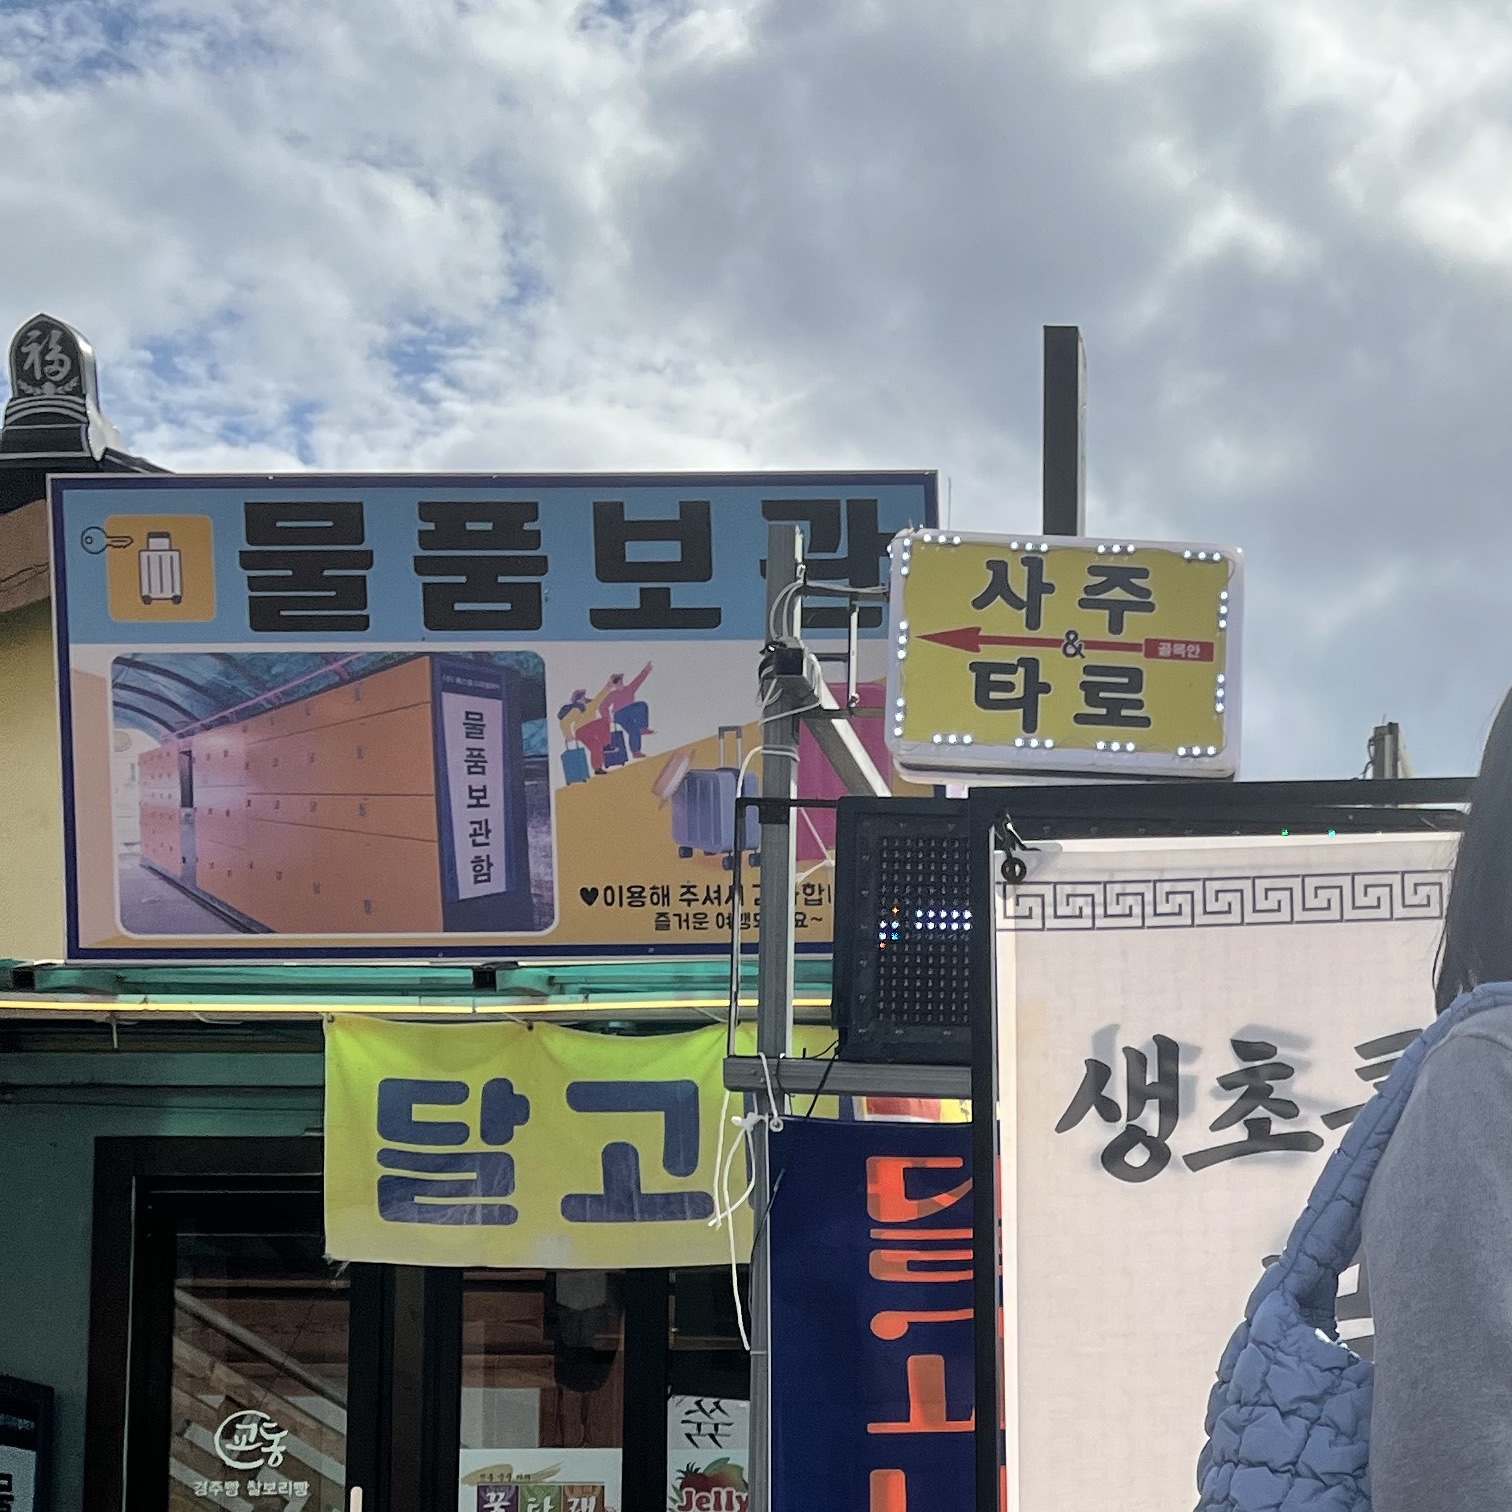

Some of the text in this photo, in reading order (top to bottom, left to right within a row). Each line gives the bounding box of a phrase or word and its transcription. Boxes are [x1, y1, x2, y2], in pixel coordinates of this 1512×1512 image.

[20, 329, 71, 381] 福
[239, 498, 898, 632] 물품보관
[970, 555, 1156, 636] 사주
[1061, 629, 1086, 659] &
[1157, 642, 1201, 659] 골목안
[968, 656, 1153, 735] 타로
[462, 710, 494, 886] 물품보관함
[603, 885, 671, 908] 이용해
[654, 911, 709, 931] 즐거운
[377, 1077, 757, 1226] 달고
[225, 1422, 289, 1467] 교동
